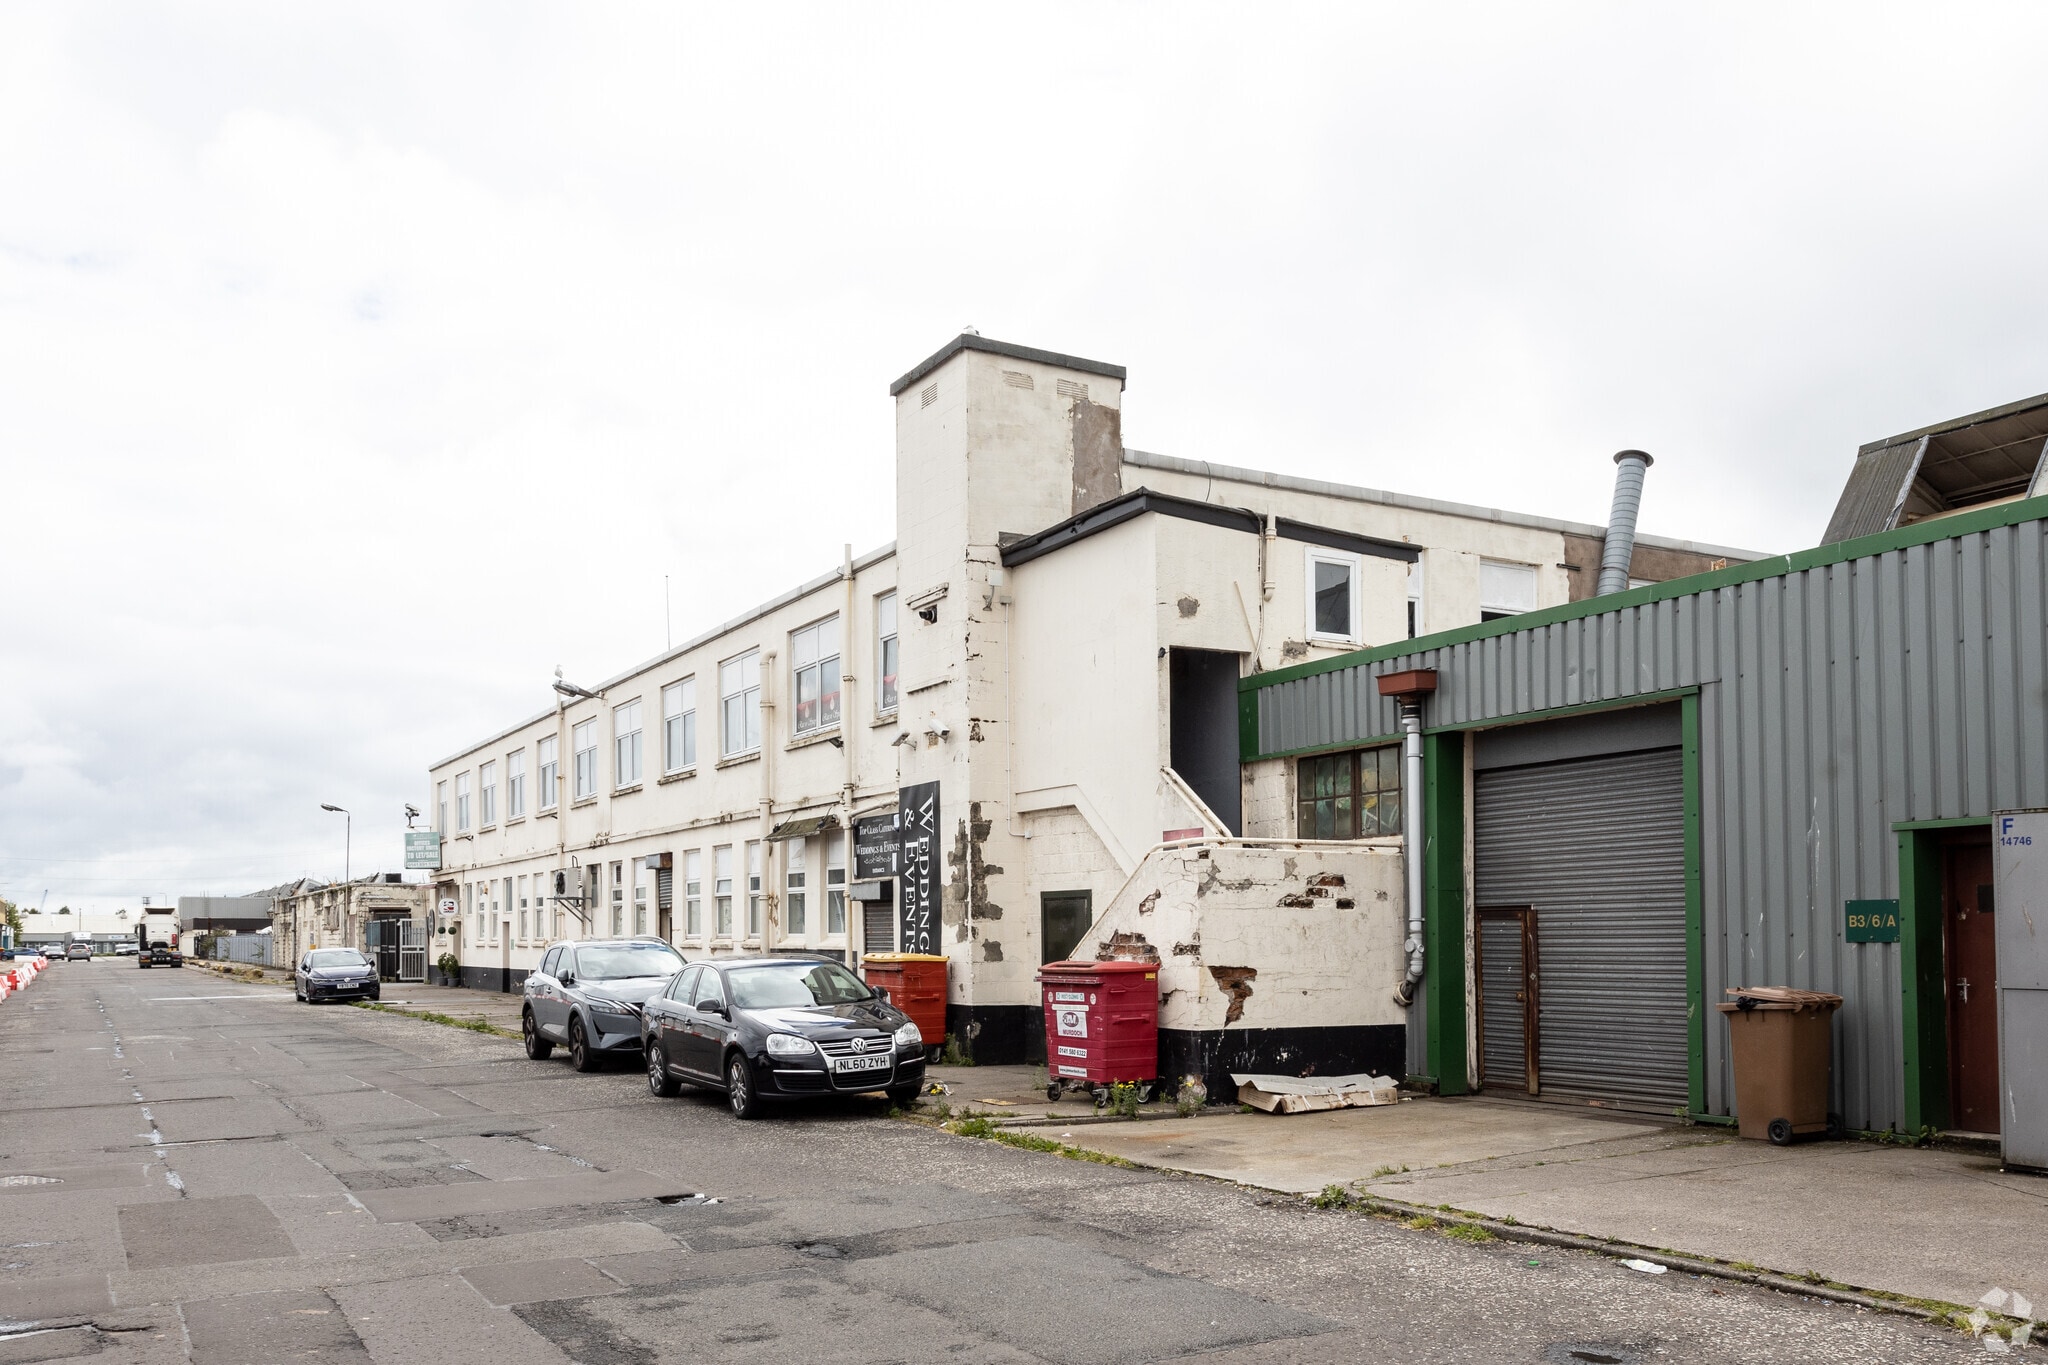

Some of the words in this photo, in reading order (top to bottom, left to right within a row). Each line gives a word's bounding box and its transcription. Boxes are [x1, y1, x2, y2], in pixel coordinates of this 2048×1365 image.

[904, 807, 915, 830] &
[2002, 817, 2014, 834] F
[2000, 836, 2032, 846] 14746
[918, 792, 934, 955] WEDDING
[1848, 913, 1896, 928] B3/6/A
[839, 1059, 866, 1071] NL60
[868, 1057, 886, 1068] ZYH
